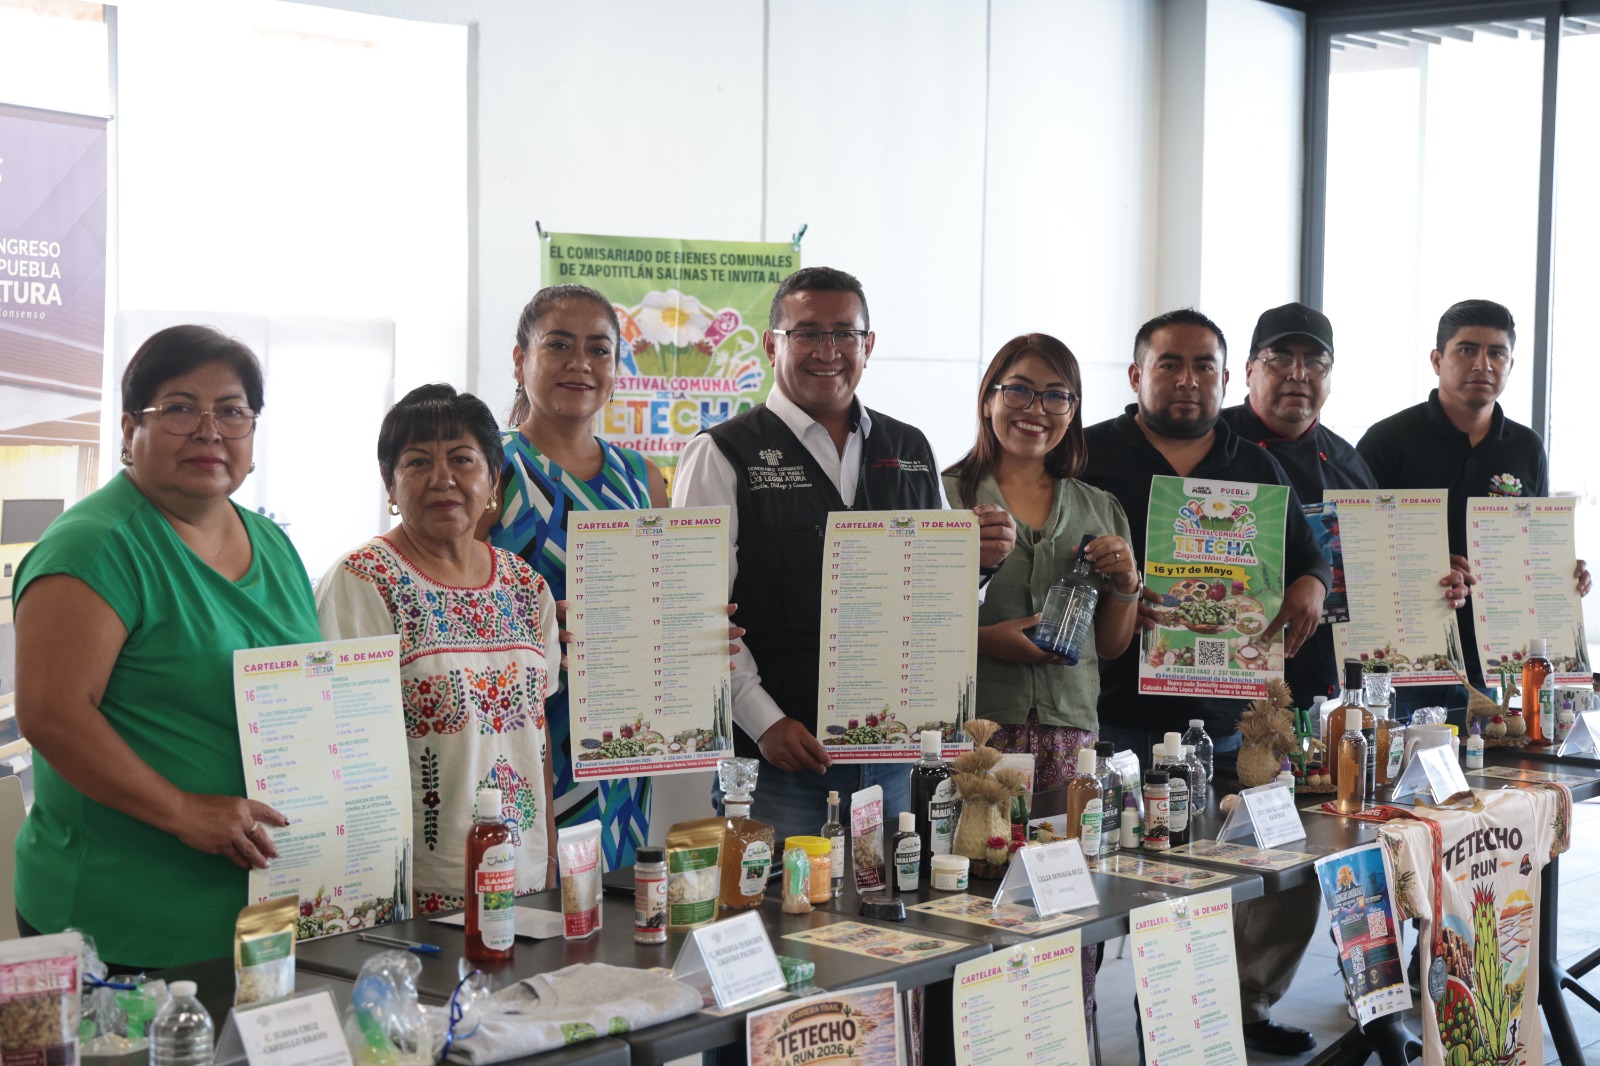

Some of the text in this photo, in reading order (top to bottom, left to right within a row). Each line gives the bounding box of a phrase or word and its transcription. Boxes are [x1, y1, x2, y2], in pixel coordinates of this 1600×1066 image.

[550, 246, 792, 268] EL COMISARIADO DE BIENES COMUNALES
[560, 263, 782, 284] DE ZAPOTITLÁN SALINAS TE INVITA AL
[0, 309, 46, 320] onsenso
[614, 377, 739, 392] ESTIVAL COMUNAL
[604, 400, 752, 434] ETECH
[610, 438, 687, 452] potitlán
[1220, 488, 1250, 496] PUEBLA
[577, 522, 630, 530] CARTELERA
[695, 518, 721, 526] MAYO
[1174, 537, 1255, 556] TETECHA
[1175, 552, 1256, 564] Zapotitlán Salinas
[1204, 566, 1232, 576] Mayo
[340, 650, 394, 663] 16 DE MAYO
[244, 660, 299, 672] CARTELERA
[305, 666, 334, 674] TETECHA
[245, 690, 256, 702] 16
[328, 744, 338, 754] 16
[256, 778, 266, 790] 16
[1443, 828, 1523, 872] TETECHO
[1470, 858, 1498, 881] RUN
[334, 886, 342, 896] 16
[1194, 903, 1228, 917] 16 DE MAYO
[1136, 916, 1168, 930] CARTELERA
[1042, 952, 1052, 960] DE
[1054, 946, 1074, 958] MAYO
[1138, 946, 1144, 958] 16
[961, 966, 1002, 985] CARTELERA
[1008, 968, 1030, 980] TETECHA
[820, 1003, 840, 1012] TRAIL
[1194, 1019, 1200, 1030] 16
[777, 1019, 856, 1058] TETECHO
[1148, 1030, 1156, 1042] 16
[793, 1044, 844, 1066] RUN 2026
